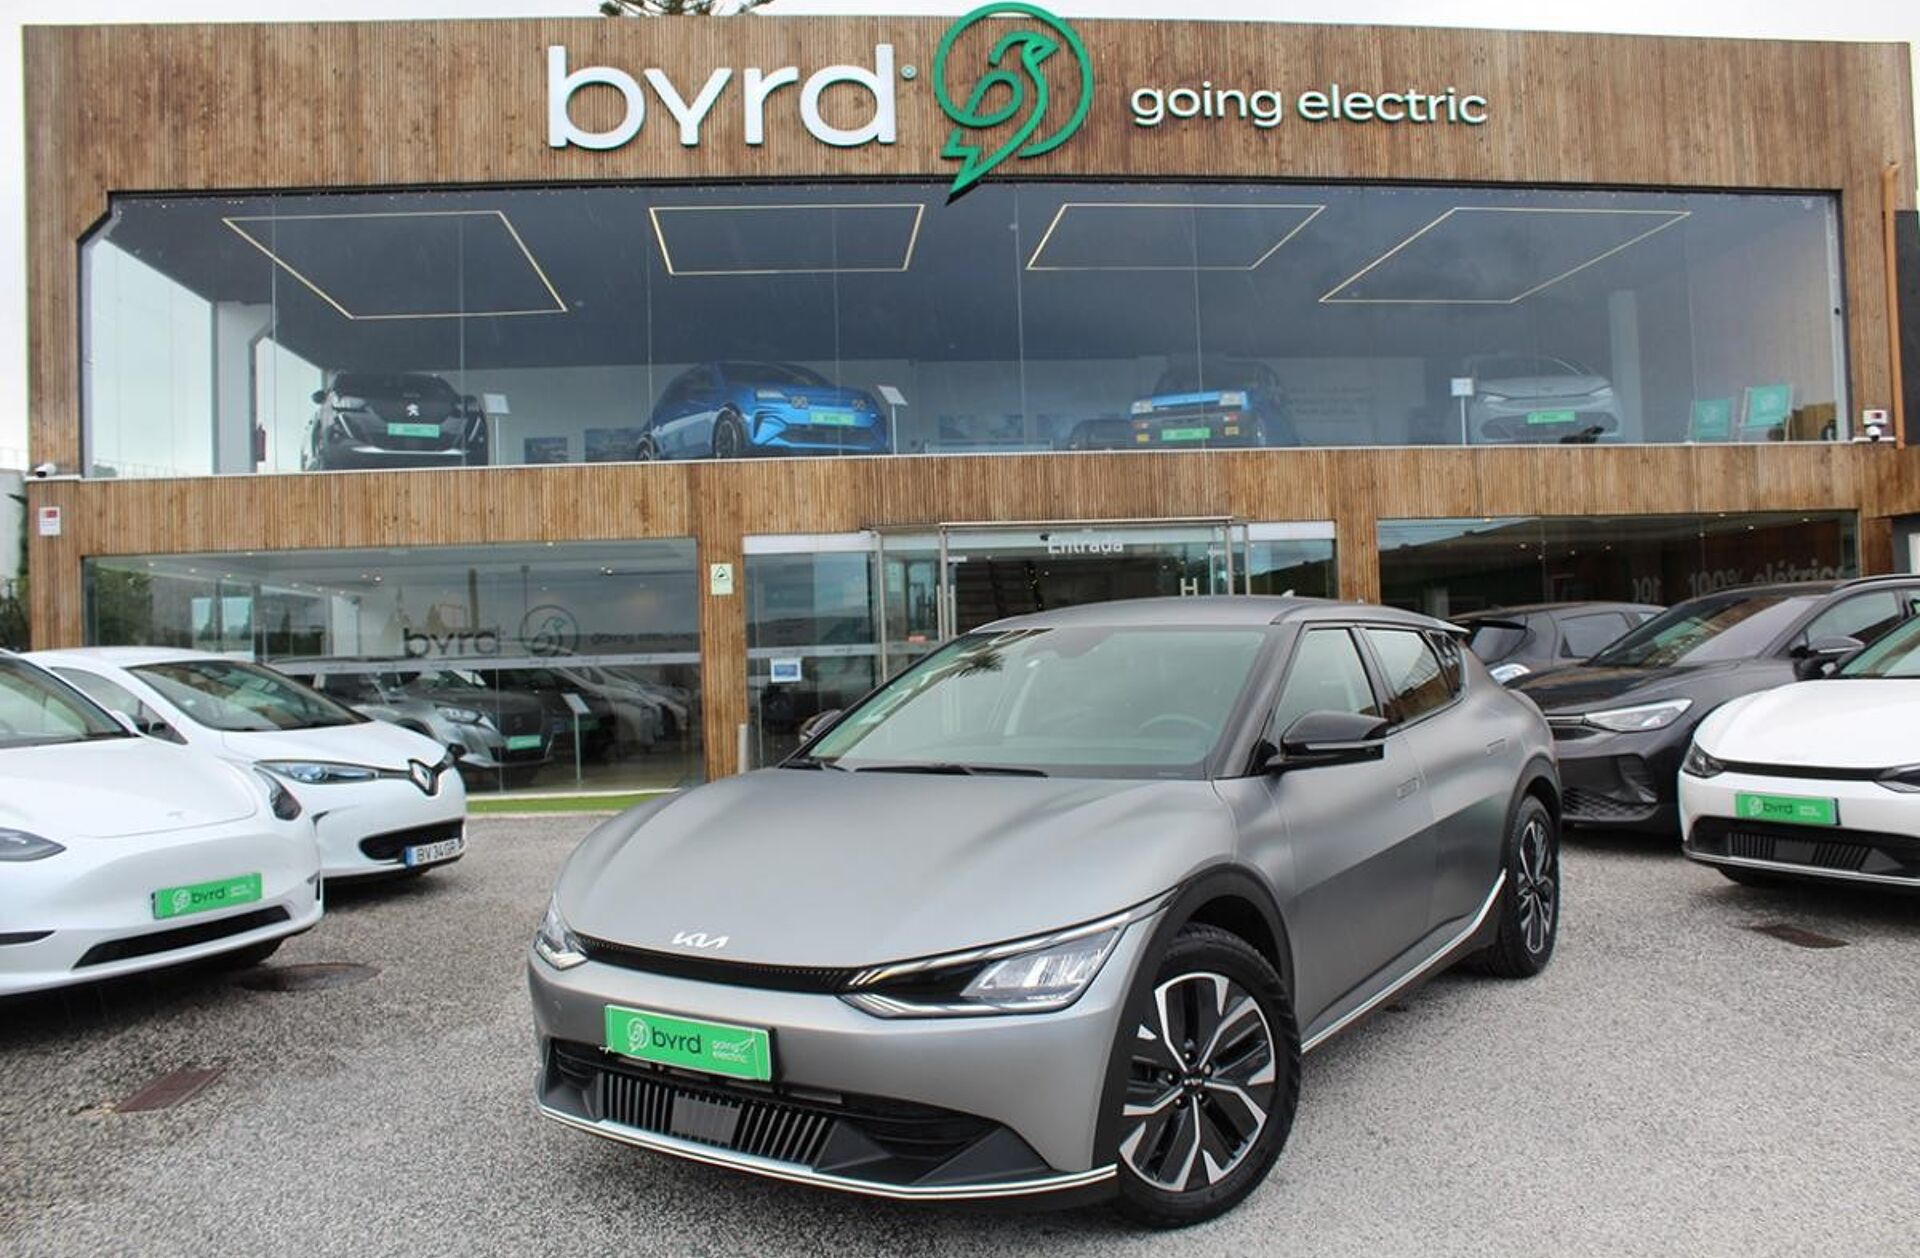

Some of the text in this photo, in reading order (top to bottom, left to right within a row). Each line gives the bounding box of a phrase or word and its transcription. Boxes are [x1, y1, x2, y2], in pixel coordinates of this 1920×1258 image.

[548, 43, 896, 149] byrd
[1131, 81, 1488, 127] going electric
[1048, 535, 1124, 554] Entrada
[402, 625, 500, 657] byrd
[191, 885, 225, 904] byrd
[651, 1026, 703, 1055] byrd
